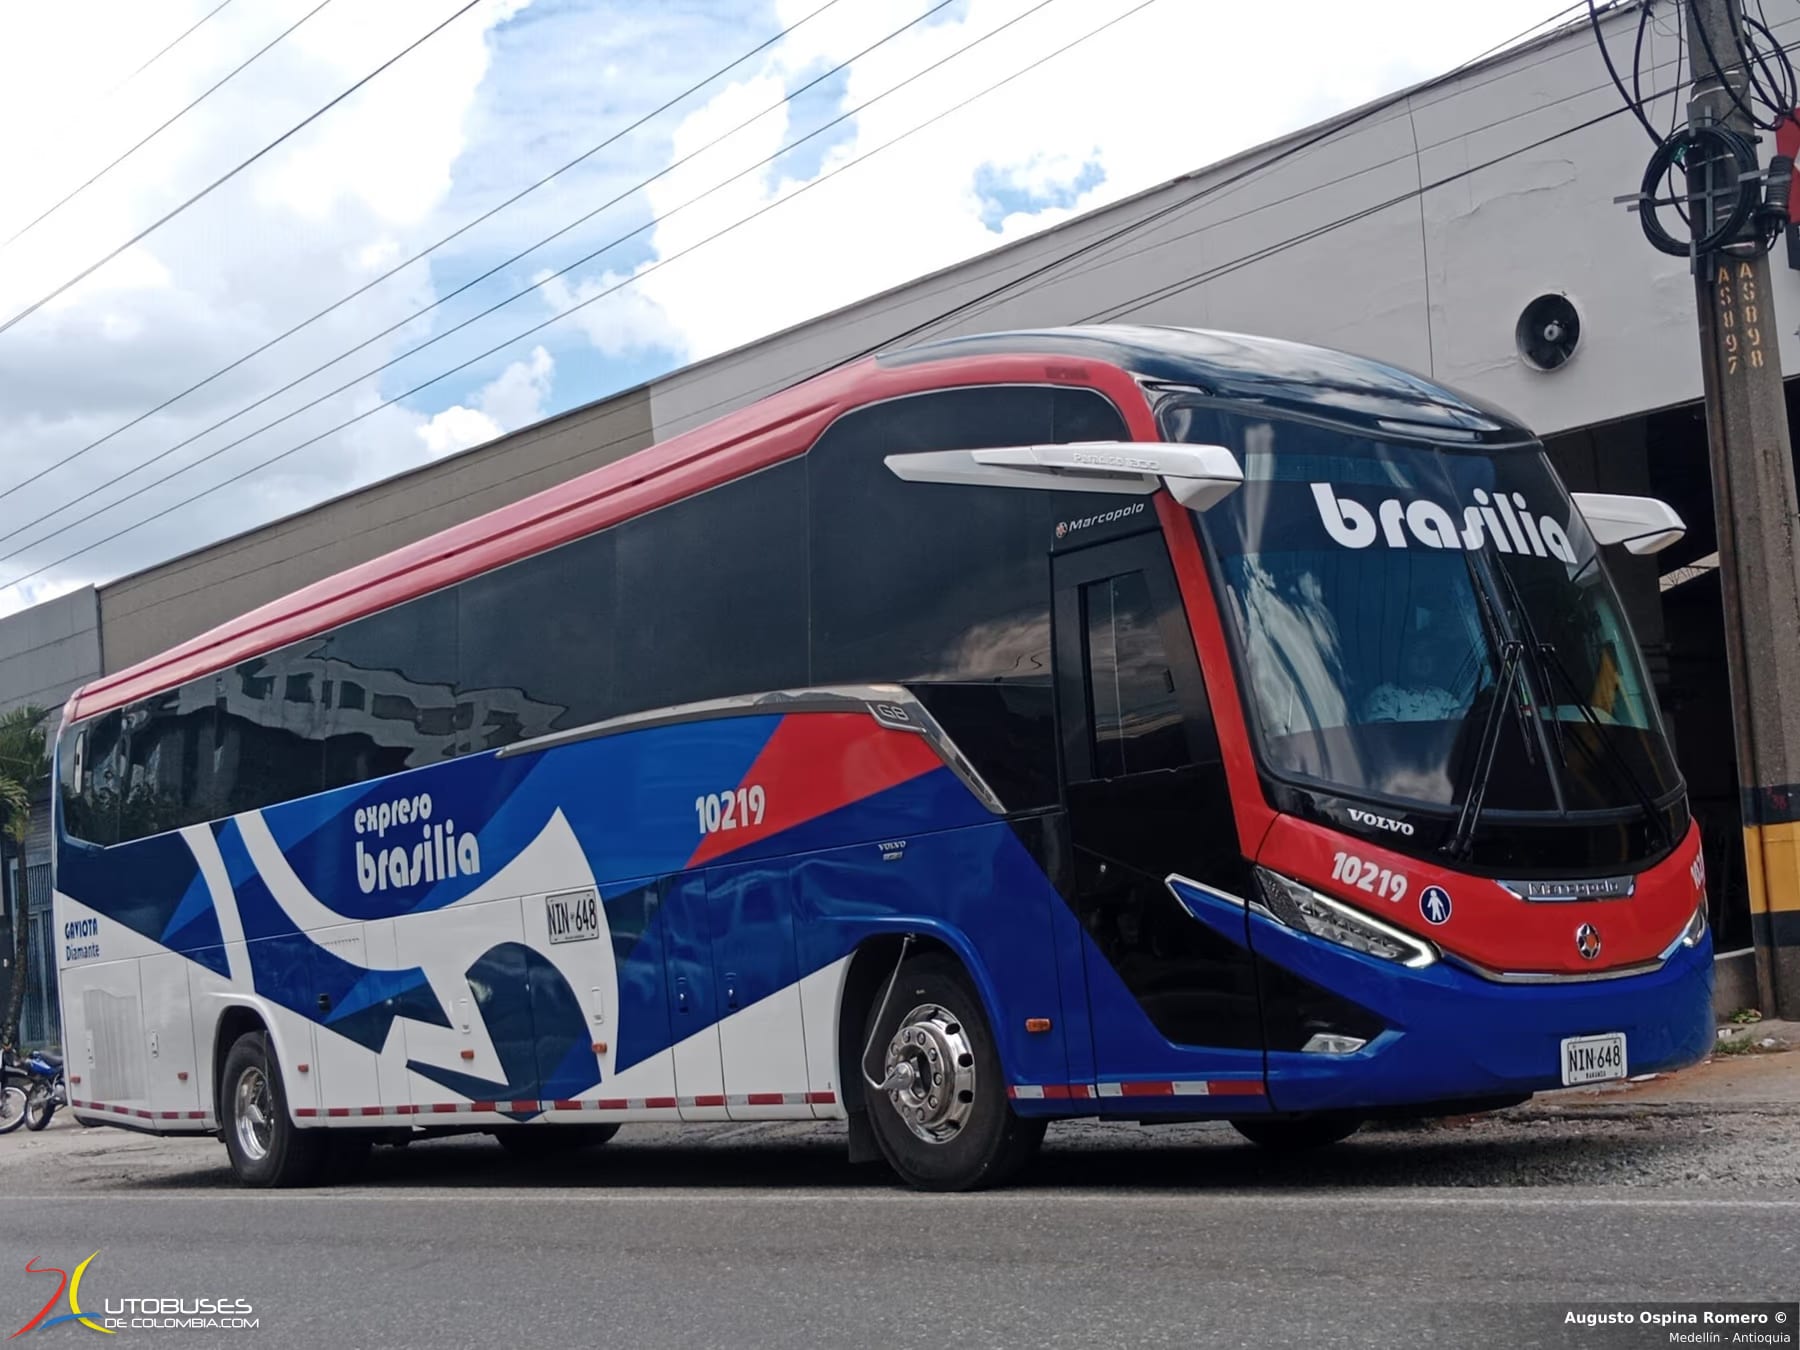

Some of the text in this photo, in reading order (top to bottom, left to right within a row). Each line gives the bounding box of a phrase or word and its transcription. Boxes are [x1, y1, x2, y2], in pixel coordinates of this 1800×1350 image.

[1068, 503, 1145, 532] Marcopolo
[1309, 483, 1578, 564] brasilia
[354, 793, 432, 838] expreso
[695, 785, 766, 834] 10219
[1346, 808, 1415, 836] VOLVO
[355, 819, 480, 894] brasilia
[1331, 852, 1408, 903] 10219
[65, 917, 98, 940] GAVIOTA
[66, 943, 100, 961] Diamante
